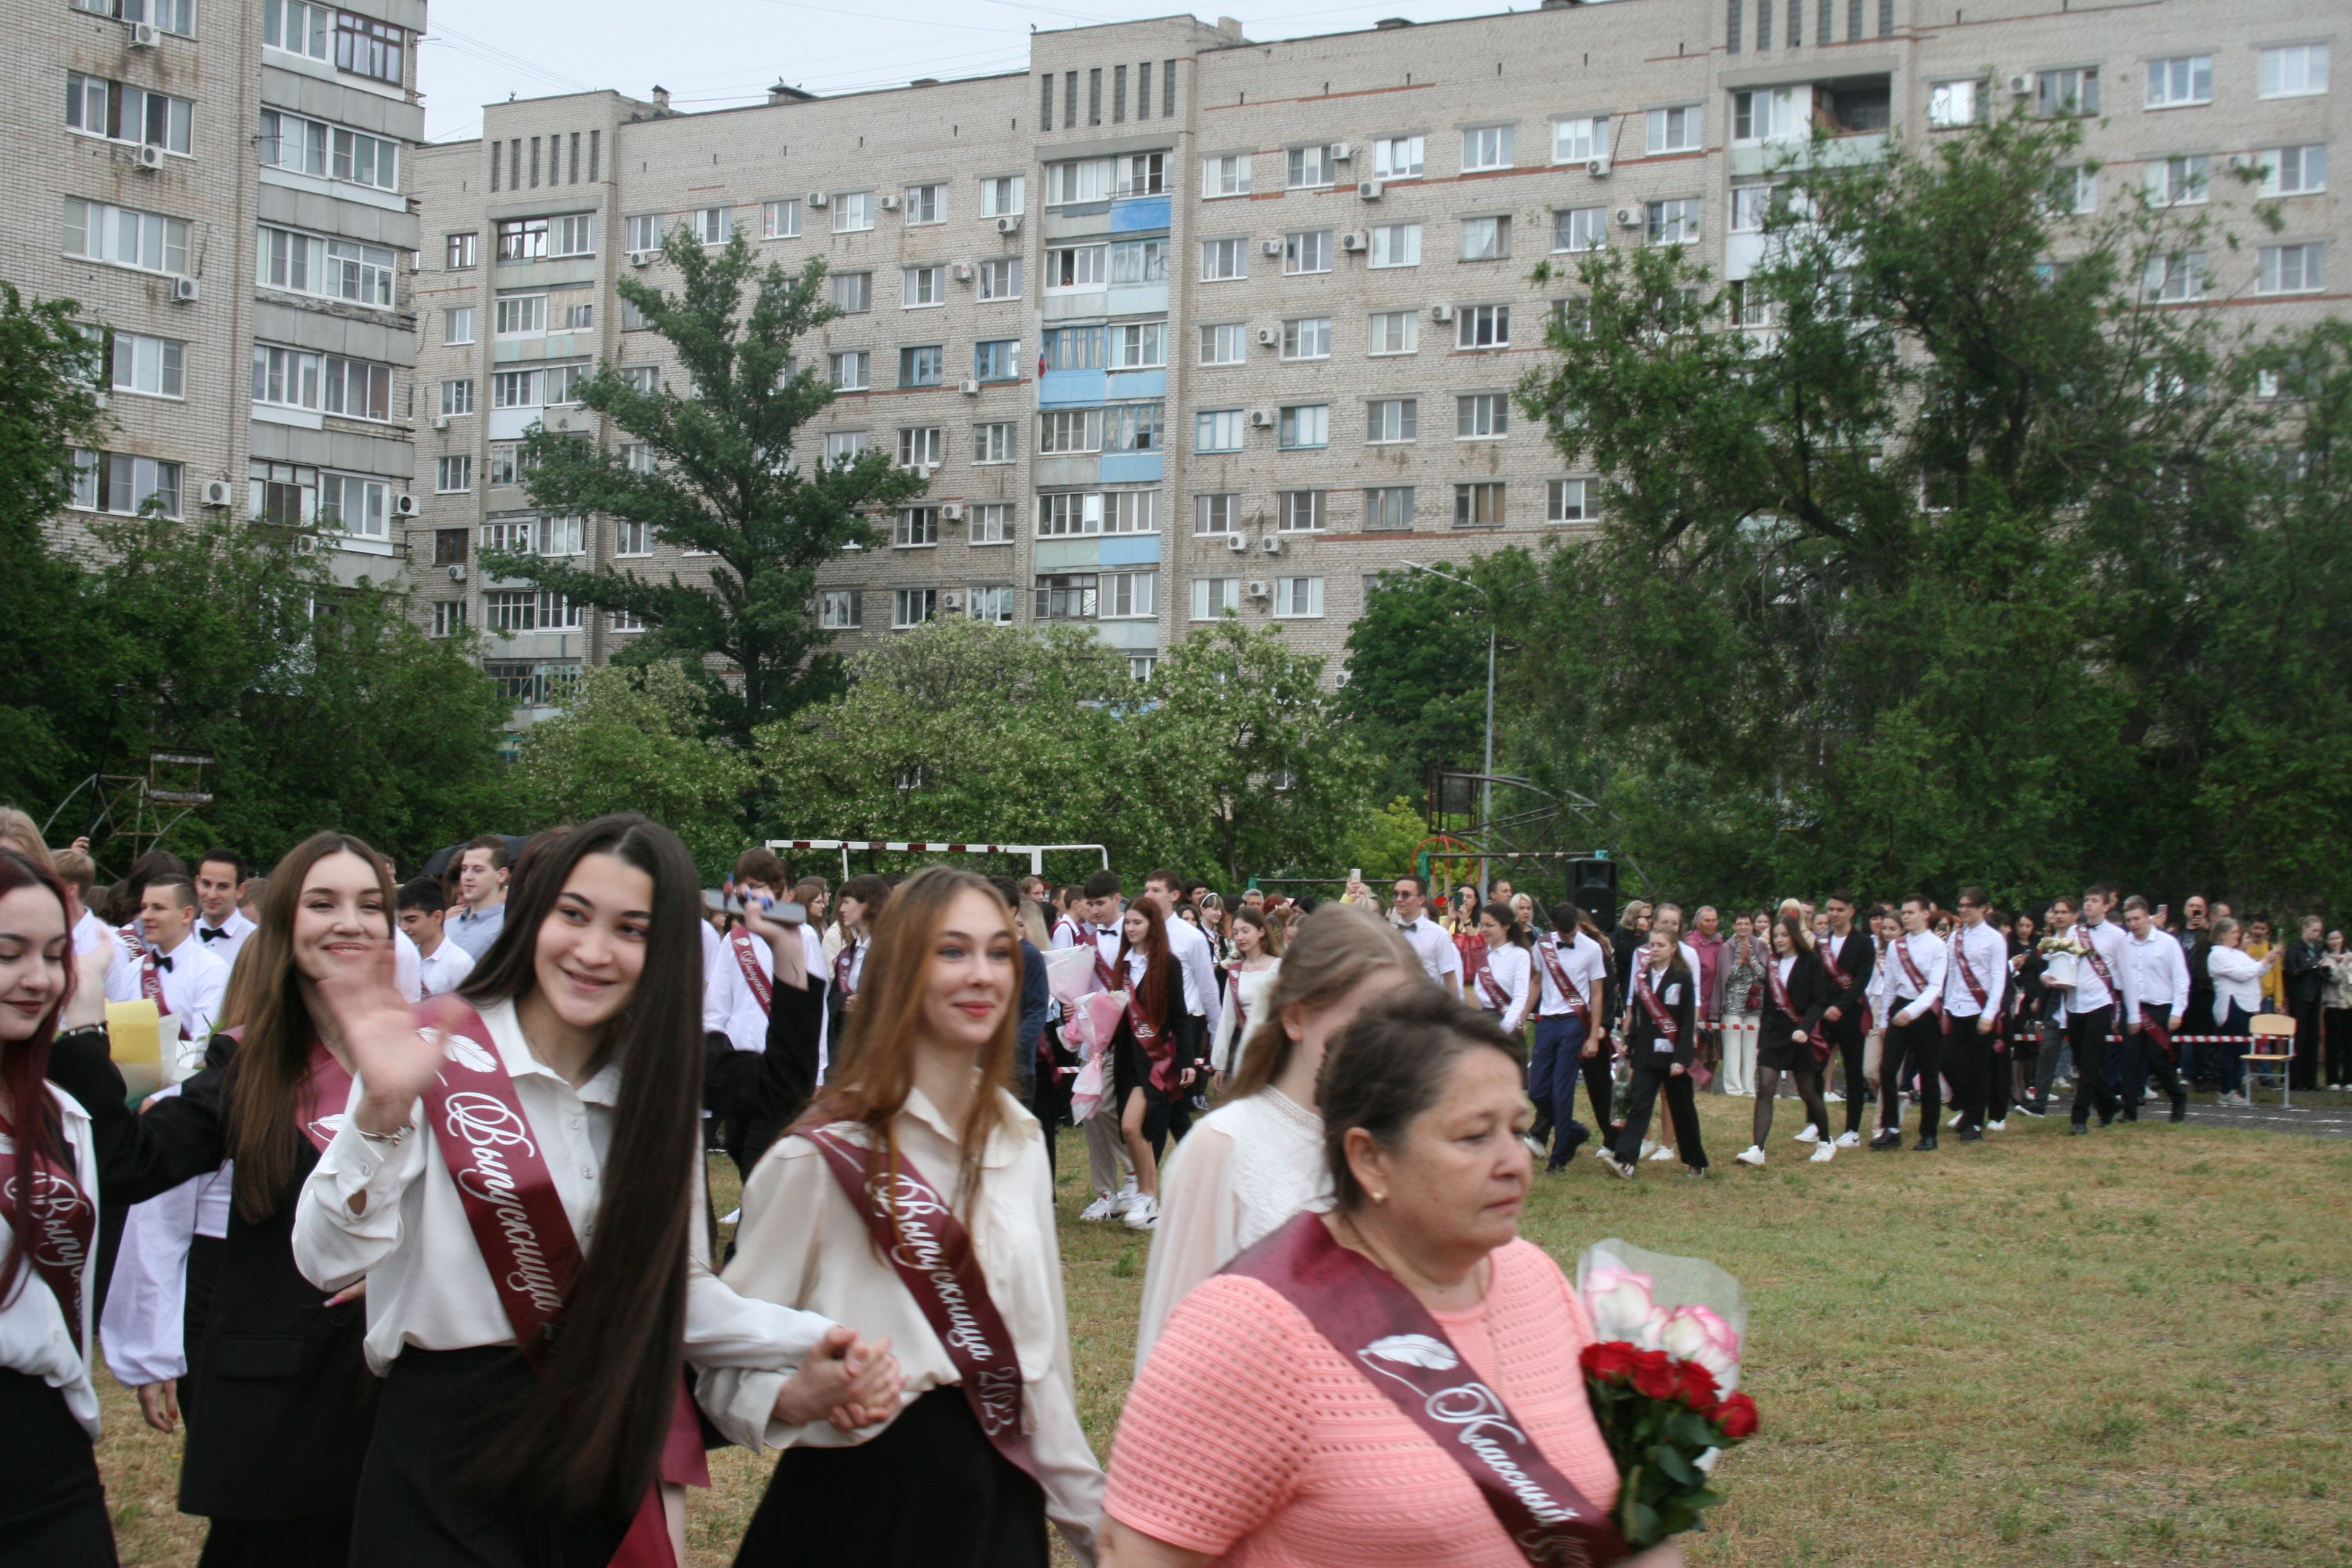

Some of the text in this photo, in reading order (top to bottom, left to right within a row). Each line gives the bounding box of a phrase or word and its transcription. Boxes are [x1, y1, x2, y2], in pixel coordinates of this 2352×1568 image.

[445, 1091, 563, 1312] Выпускница
[864, 1172, 1018, 1436] Выпускница 2023
[1425, 1382, 1581, 1527] Классный
